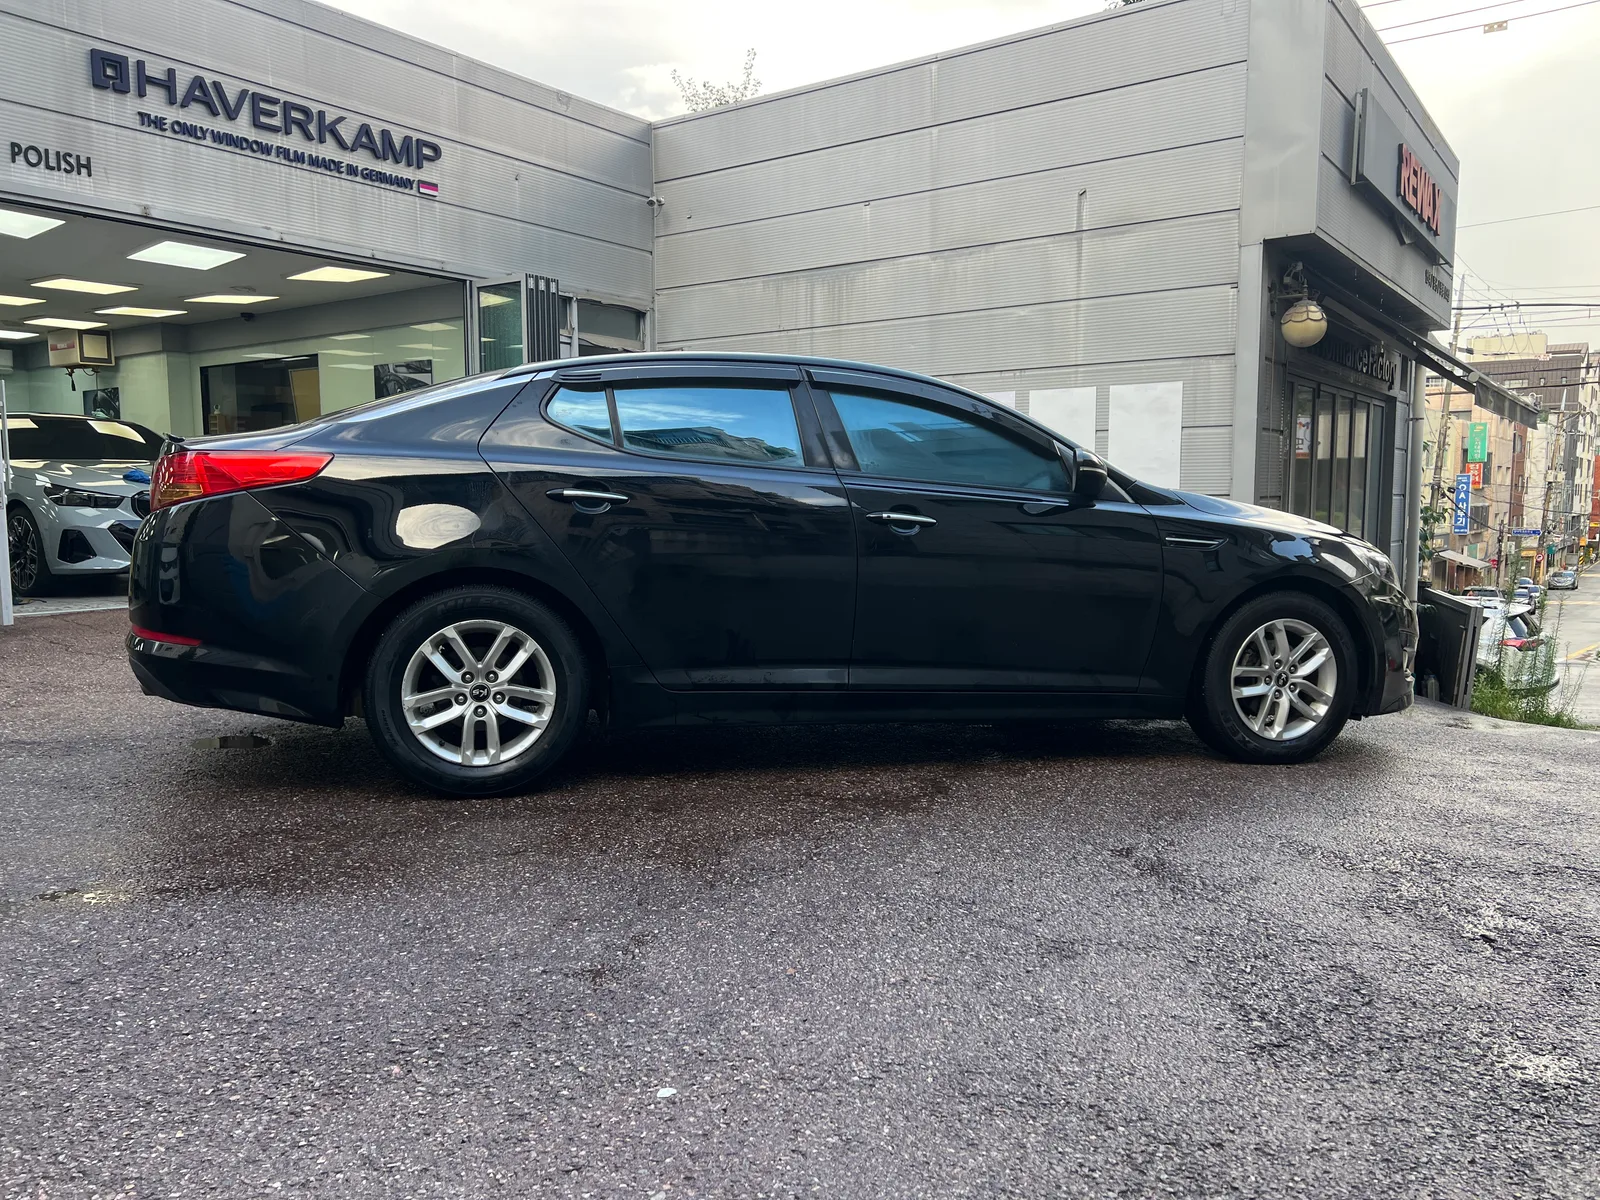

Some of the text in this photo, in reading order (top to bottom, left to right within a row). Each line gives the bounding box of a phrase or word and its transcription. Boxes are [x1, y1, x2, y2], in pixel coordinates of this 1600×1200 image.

[136, 59, 442, 170] HAVERKAMP
[138, 110, 417, 192] THE ONLY WINDOW FILM MADE IN GERMANY
[10, 141, 93, 177] POLISH
[1397, 143, 1443, 237] REWAX
[471, 687, 489, 699] K5
